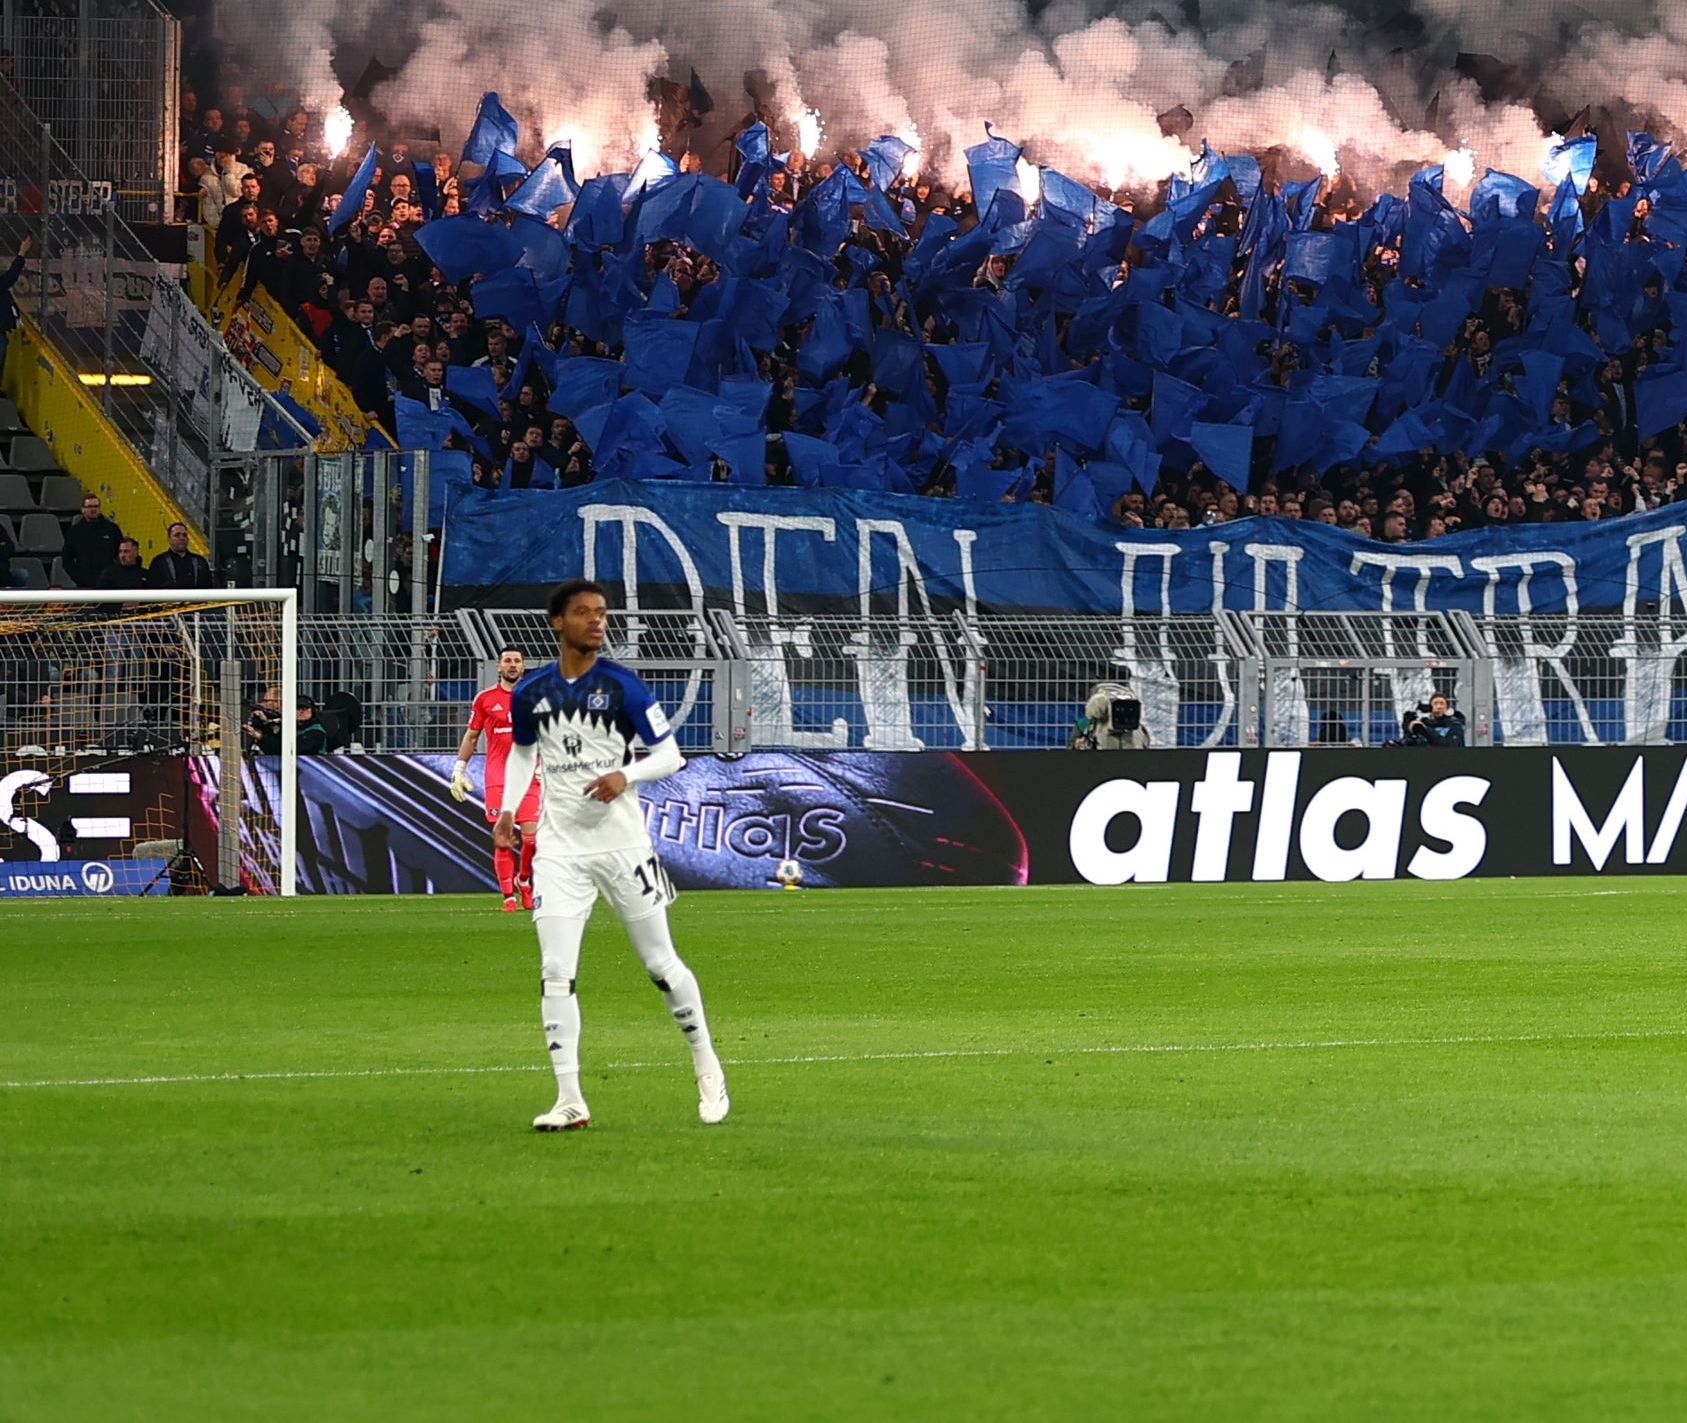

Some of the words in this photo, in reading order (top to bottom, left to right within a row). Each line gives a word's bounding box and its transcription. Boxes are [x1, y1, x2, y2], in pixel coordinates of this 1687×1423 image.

[576, 503, 988, 751] DEN
[641, 798, 847, 864] tlas
[1068, 750, 1491, 883] atlas
[10, 875, 76, 892] IDUNA
